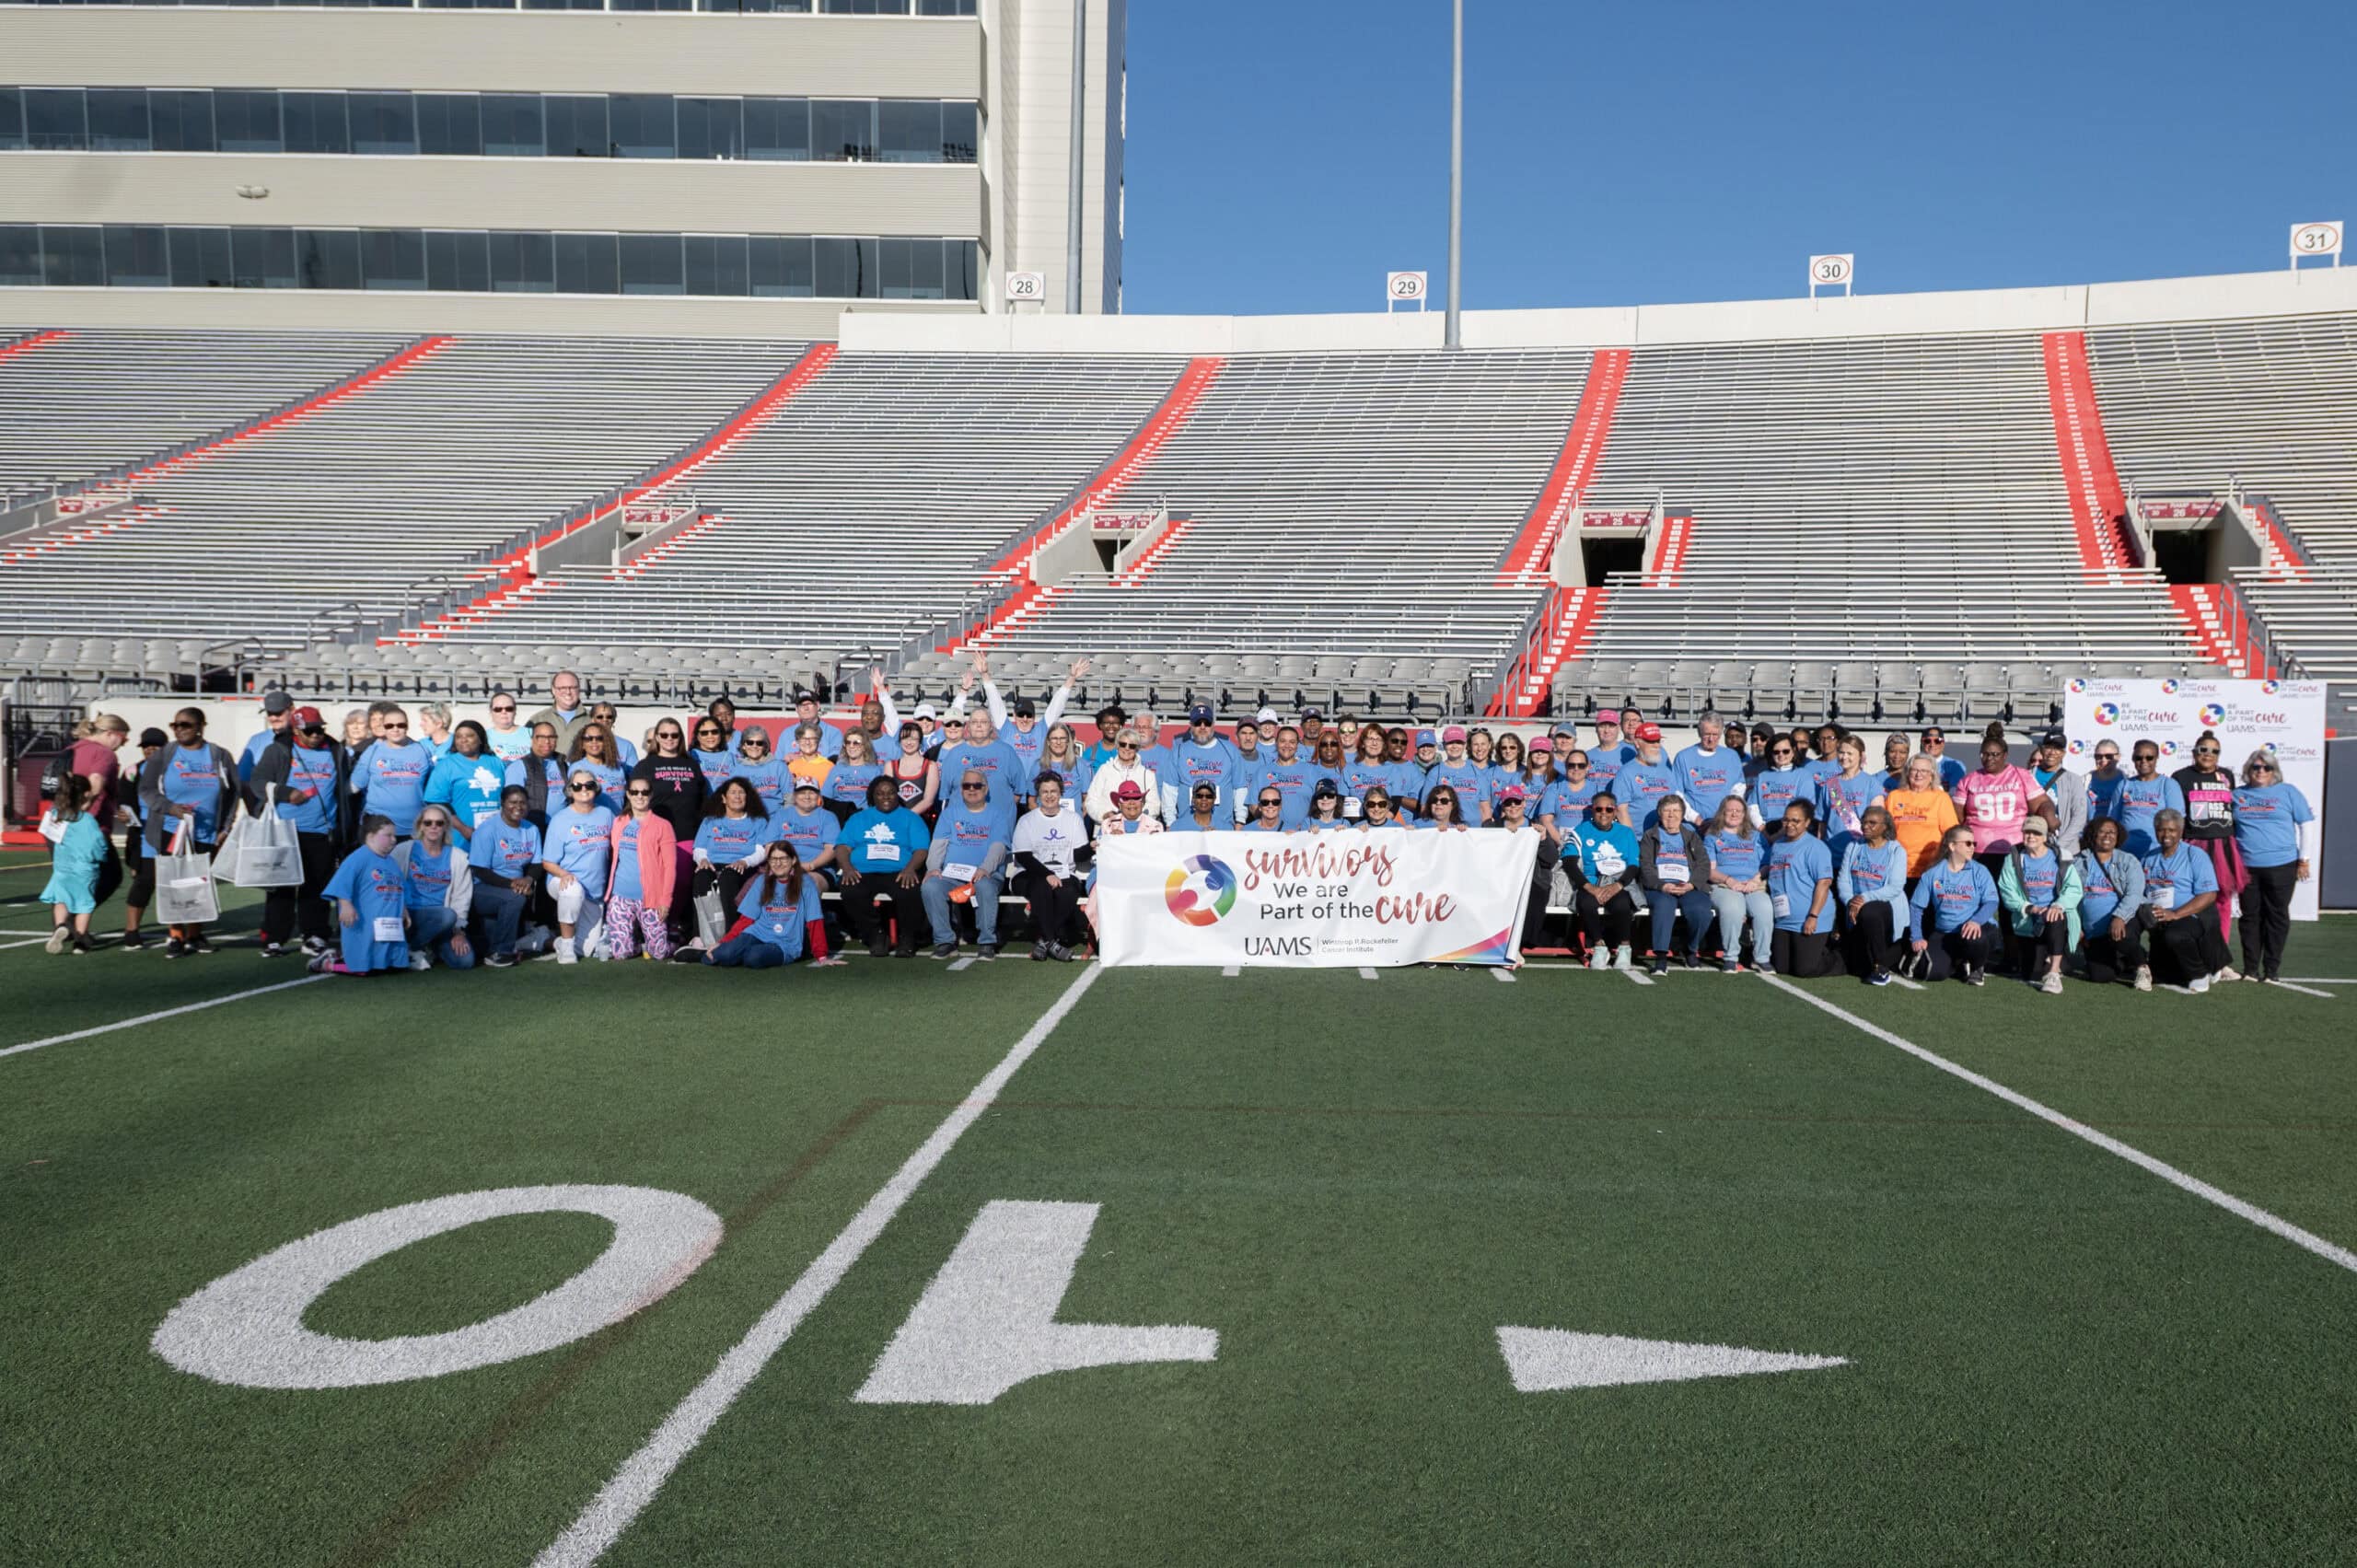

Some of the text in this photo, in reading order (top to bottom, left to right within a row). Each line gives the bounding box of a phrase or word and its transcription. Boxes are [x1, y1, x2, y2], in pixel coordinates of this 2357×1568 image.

[2305, 233, 2325, 249] 31
[1822, 264, 1840, 278] 30
[1016, 280, 1033, 294] 28
[1398, 281, 1416, 294] 29
[1612, 517, 1623, 526] 25
[2148, 711, 2178, 723] cure
[2255, 713, 2286, 723] cure
[2226, 725, 2256, 733] UAMS
[655, 771, 694, 779] SURVIVOR
[1273, 883, 1349, 899] We are
[1260, 891, 1457, 925] Part of the cure
[1245, 936, 1312, 956] UAMS
